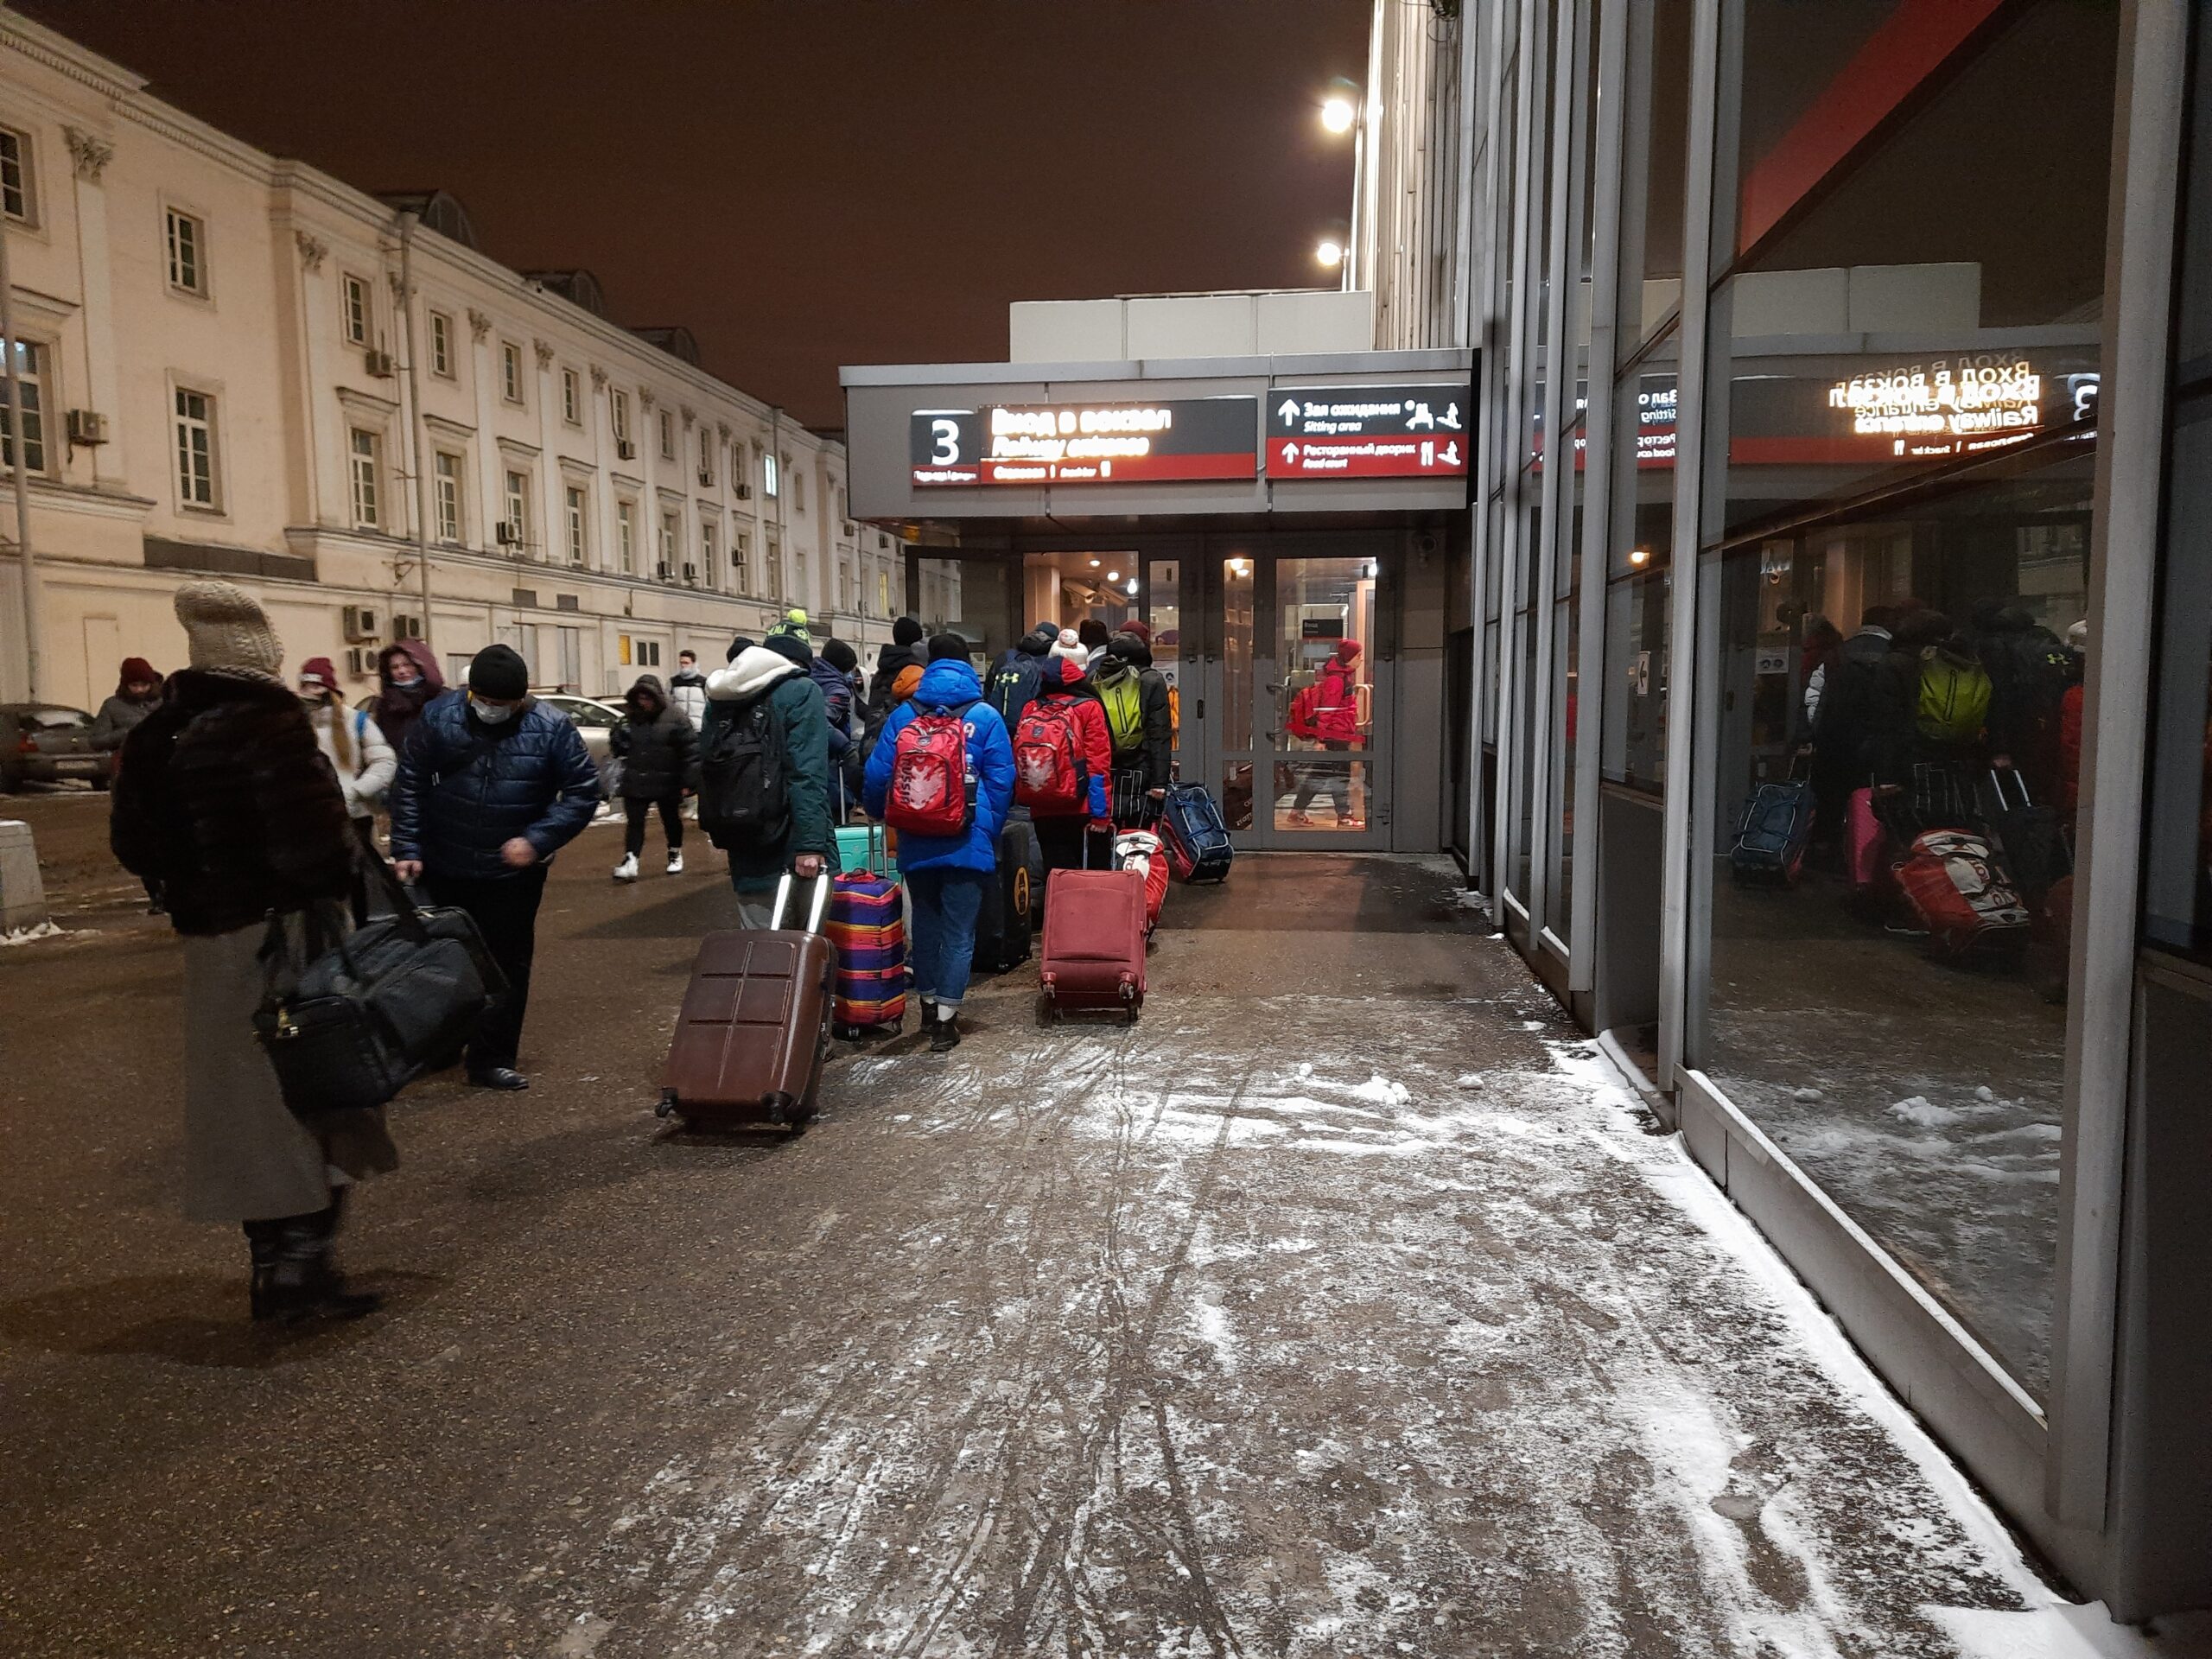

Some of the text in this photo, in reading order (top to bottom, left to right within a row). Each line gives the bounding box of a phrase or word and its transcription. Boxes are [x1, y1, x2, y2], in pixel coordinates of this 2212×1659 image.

[1303, 402, 1329, 417] Зал
[1303, 420, 1363, 434] Sitting area
[931, 419, 960, 466] 3
